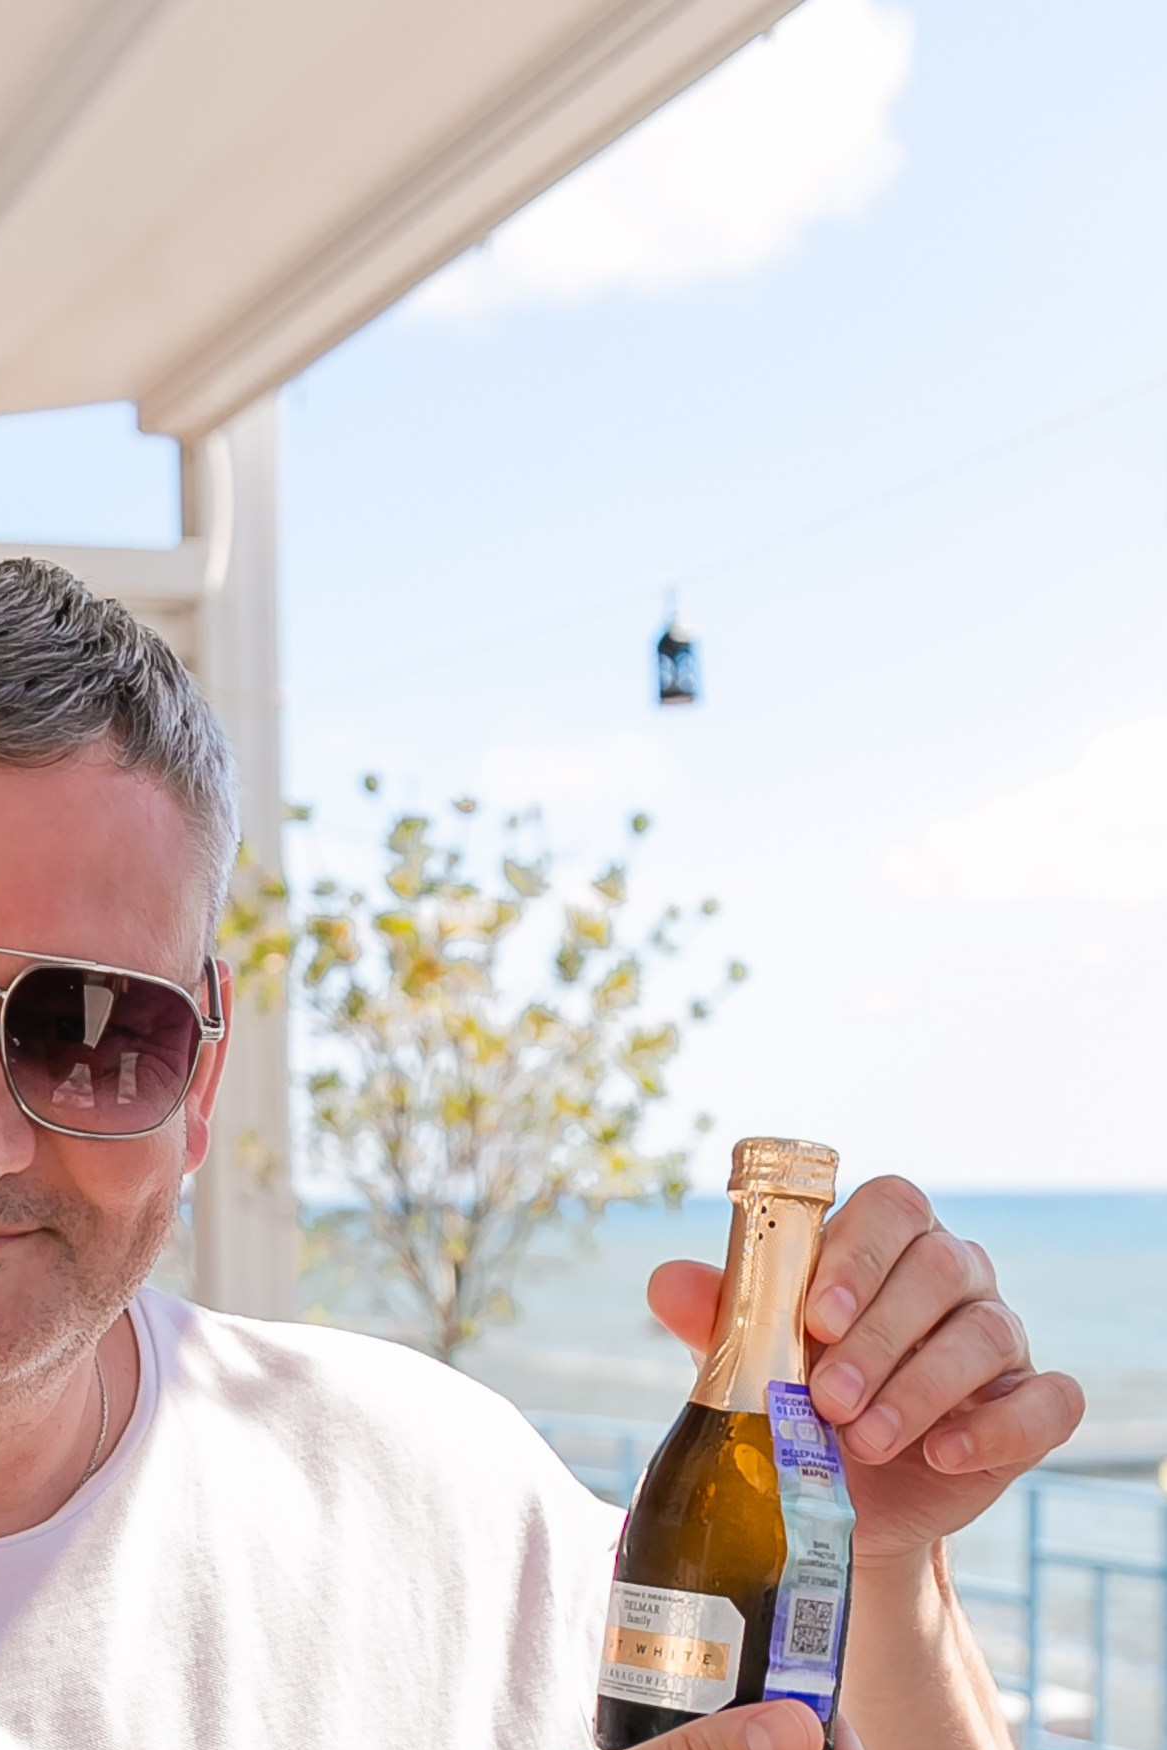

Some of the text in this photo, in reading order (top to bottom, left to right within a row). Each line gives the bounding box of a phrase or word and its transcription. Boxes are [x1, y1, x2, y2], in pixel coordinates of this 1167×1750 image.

[776, 1405, 813, 1416] ФЕДЕРА
[624, 1599, 660, 1615] DELMAR
[627, 1612, 651, 1628] family
[635, 1643, 711, 1665] WHITE
